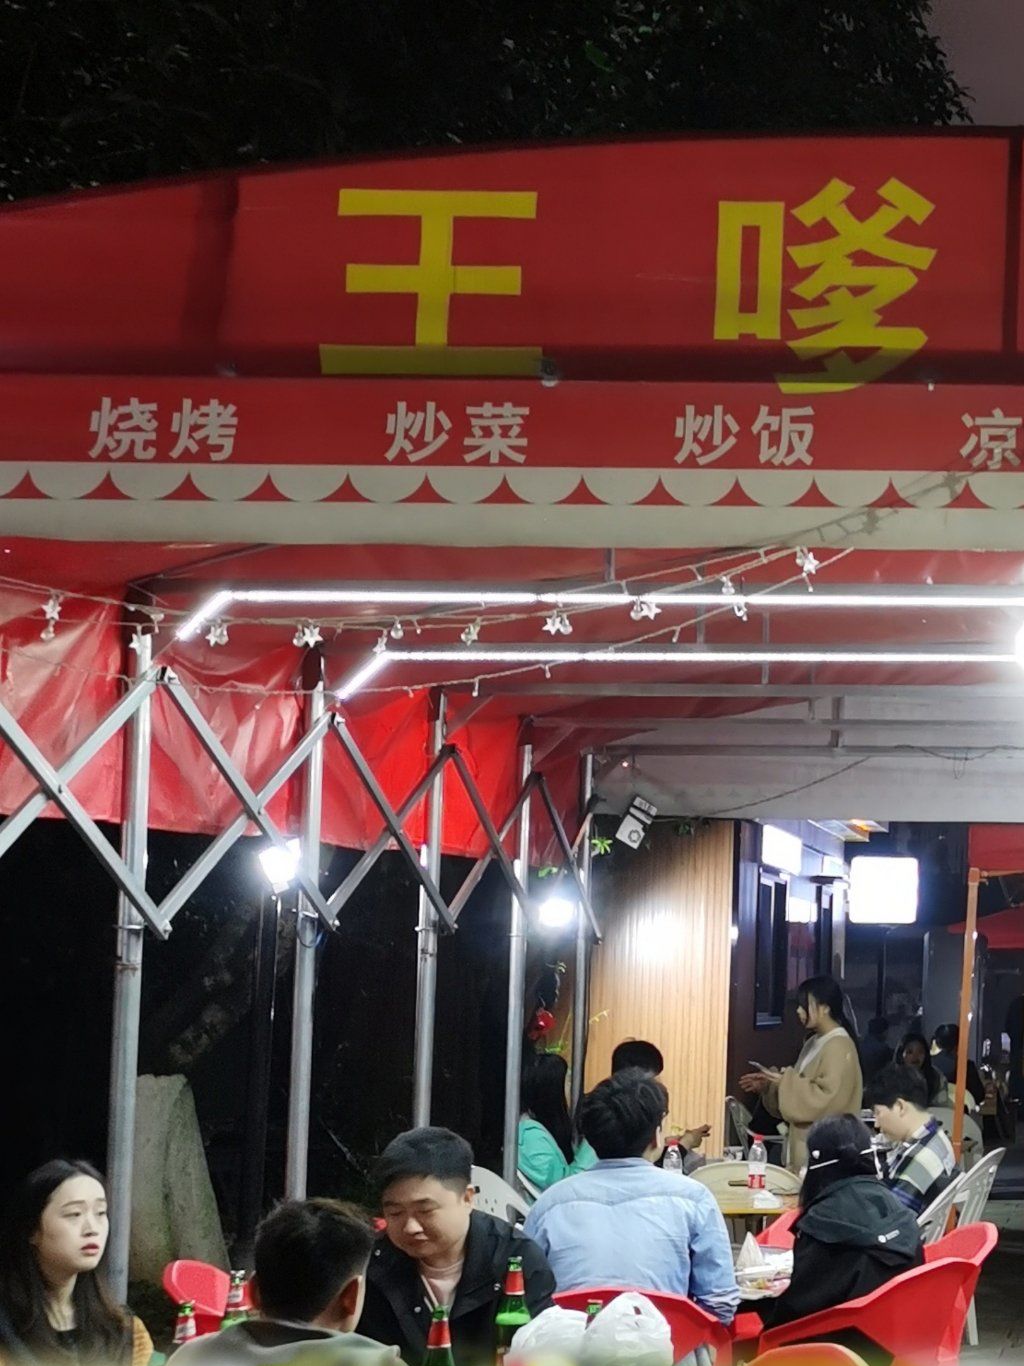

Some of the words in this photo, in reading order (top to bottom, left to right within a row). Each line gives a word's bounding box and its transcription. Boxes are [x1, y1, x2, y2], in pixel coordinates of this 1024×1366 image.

[88, 397, 238, 462] 烧烤
[385, 401, 530, 466] 炒菜
[673, 405, 816, 466] 炒饭
